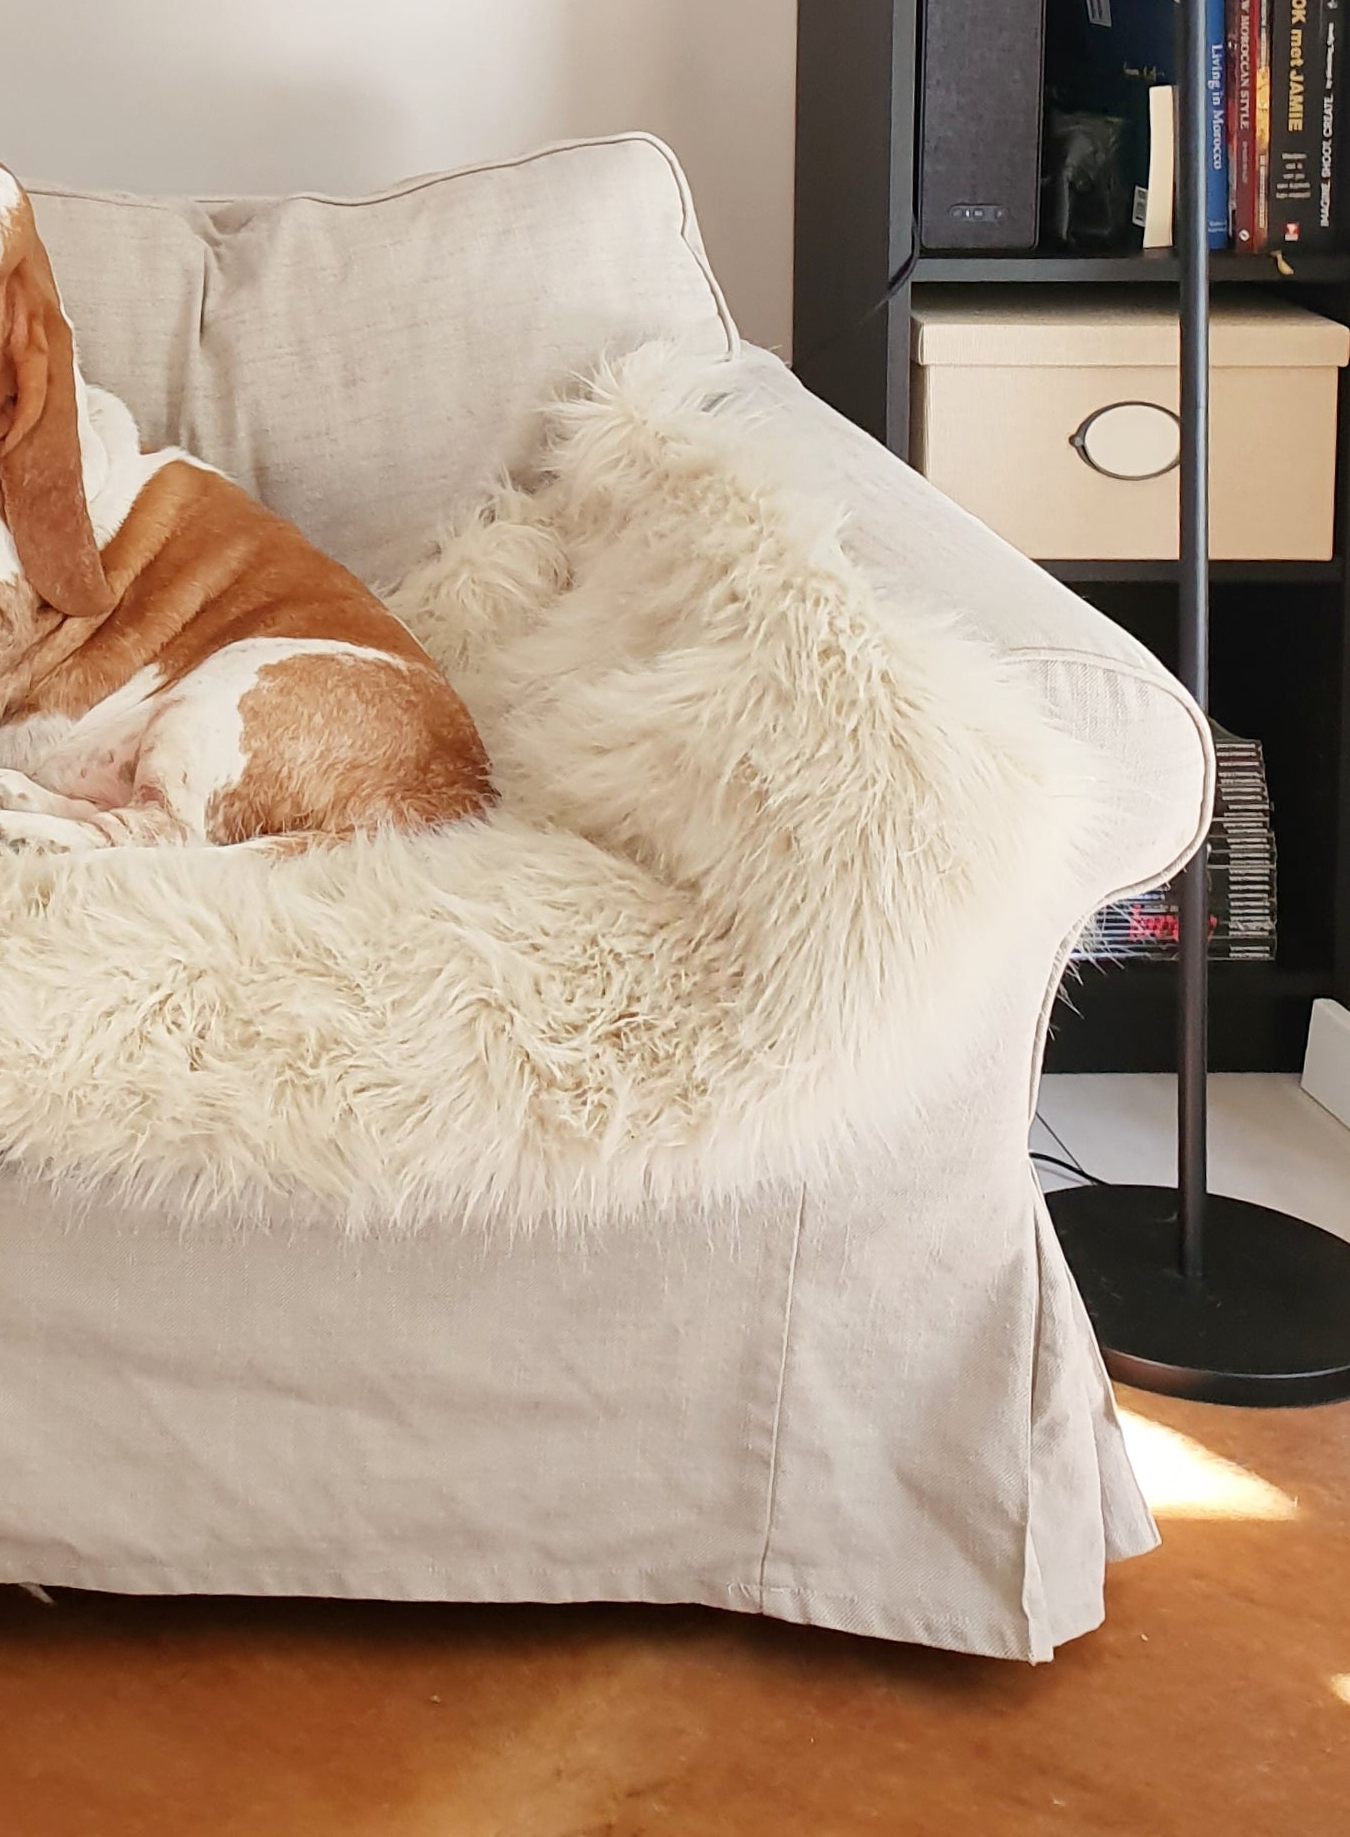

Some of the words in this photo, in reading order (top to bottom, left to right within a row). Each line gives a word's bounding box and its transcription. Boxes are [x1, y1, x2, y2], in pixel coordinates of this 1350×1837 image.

[1209, 44, 1223, 89] Living
[1239, 14, 1249, 88] MOROCCAN
[1289, 29, 1305, 66] met
[1212, 91, 1222, 106] in
[1240, 90, 1249, 130] STYLE
[1288, 70, 1305, 132] JAMIE
[1212, 109, 1223, 170] Morocco
